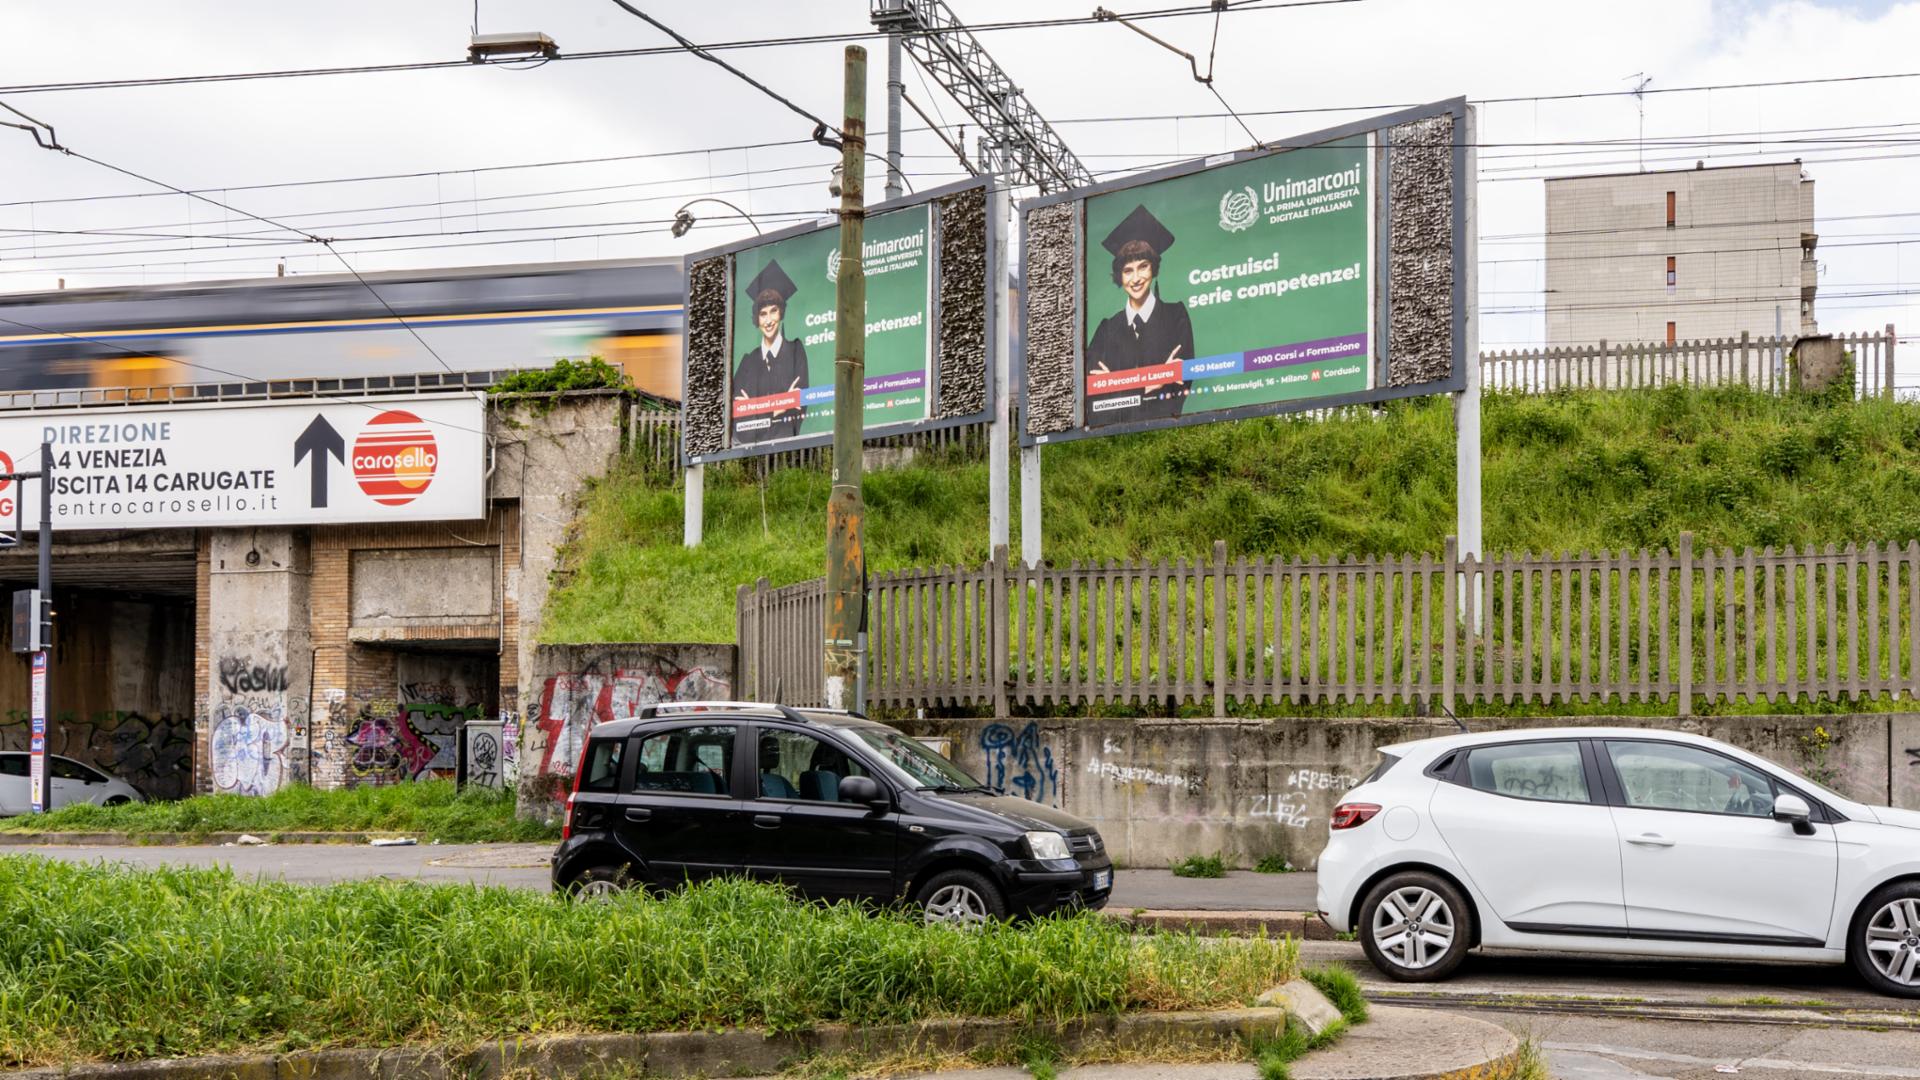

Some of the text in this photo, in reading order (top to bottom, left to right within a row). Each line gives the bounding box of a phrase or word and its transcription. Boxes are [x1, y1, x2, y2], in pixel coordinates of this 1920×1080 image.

[1263, 162, 1360, 203] Unimarconi
[1263, 186, 1360, 215] LA PRIMA UNIVERSITÀ
[1269, 200, 1353, 225] DIGITALE ITALIANA
[866, 256, 886, 269] PRIMA
[889, 259, 919, 272] ITALIANA
[1188, 252, 1280, 285] Costruisci
[1188, 262, 1362, 308] serie competenze!
[864, 311, 923, 338] petenze!
[1252, 355, 1272, 364] +100
[1274, 350, 1297, 362] Corsi
[1306, 342, 1361, 356] Formazione
[1206, 360, 1236, 371] Master
[1108, 373, 1141, 386] Percorsi
[1212, 384, 1225, 393] Via
[1266, 376, 1275, 386] 16
[1281, 373, 1309, 385] Milano
[1323, 365, 1361, 379] Cordusio
[43, 422, 171, 444] DIREZIONE
[77, 447, 167, 469] VENEZIA
[354, 447, 436, 469] carosello
[126, 473, 148, 494] 14
[153, 470, 275, 492] CARUGATE
